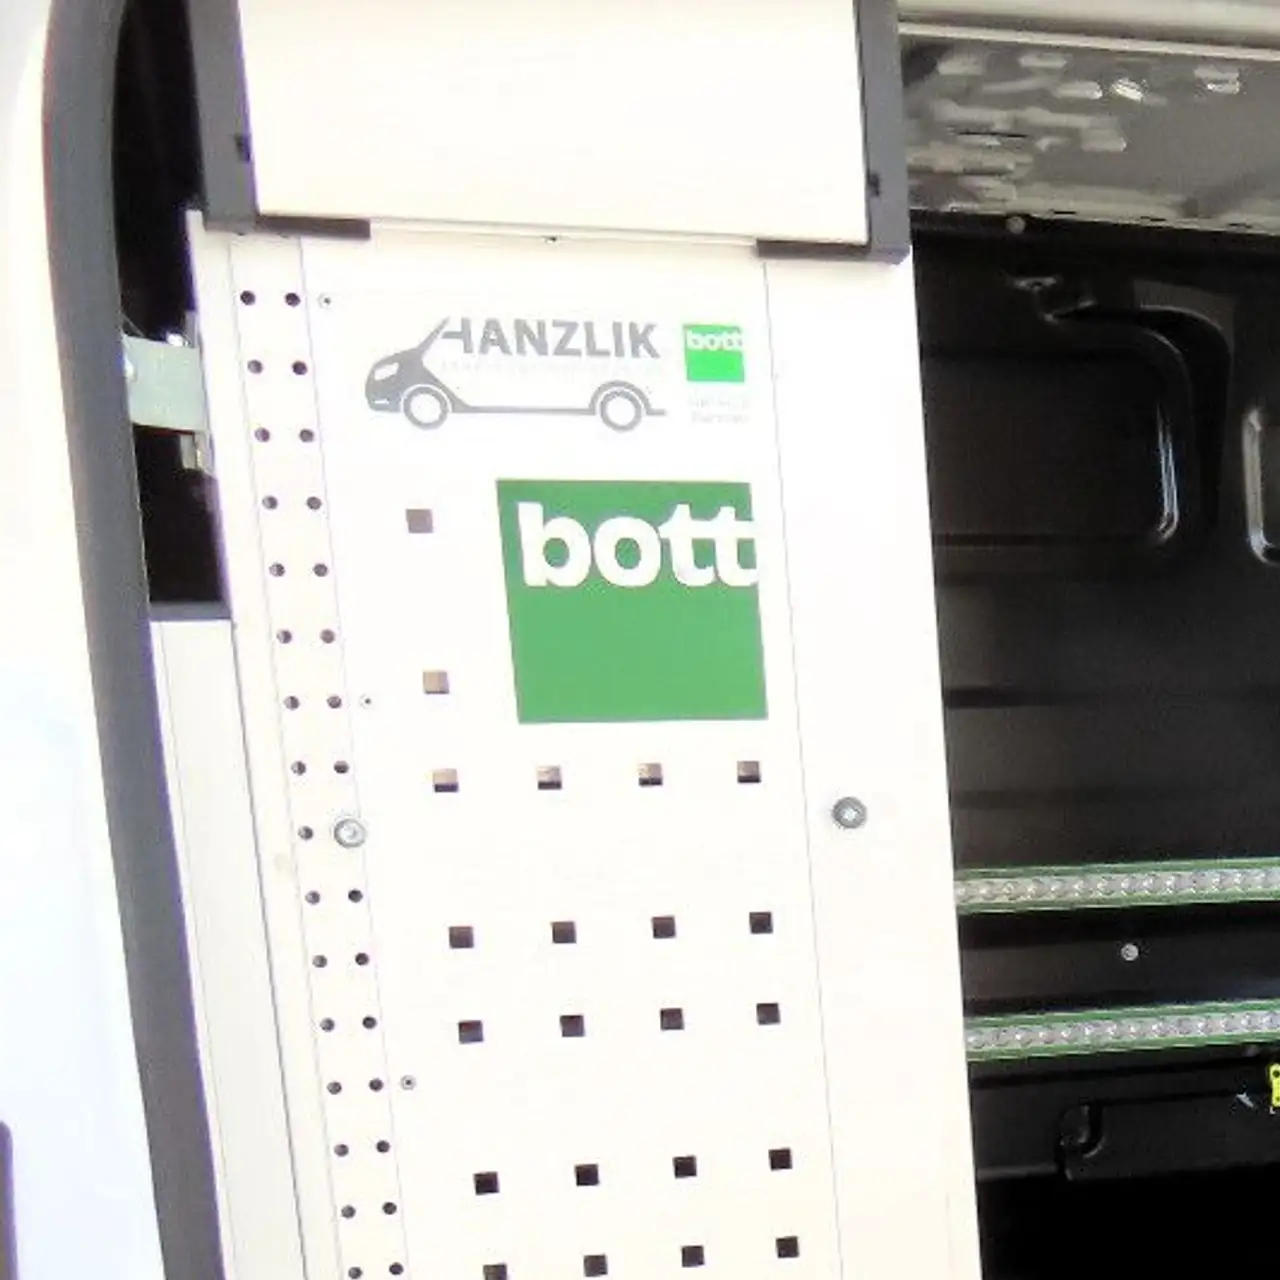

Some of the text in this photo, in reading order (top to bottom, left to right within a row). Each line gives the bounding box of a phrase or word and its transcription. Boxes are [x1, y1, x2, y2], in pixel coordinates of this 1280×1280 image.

[440, 317, 660, 359] HANZLIK
[687, 330, 743, 351] bott
[517, 501, 758, 587] bott
